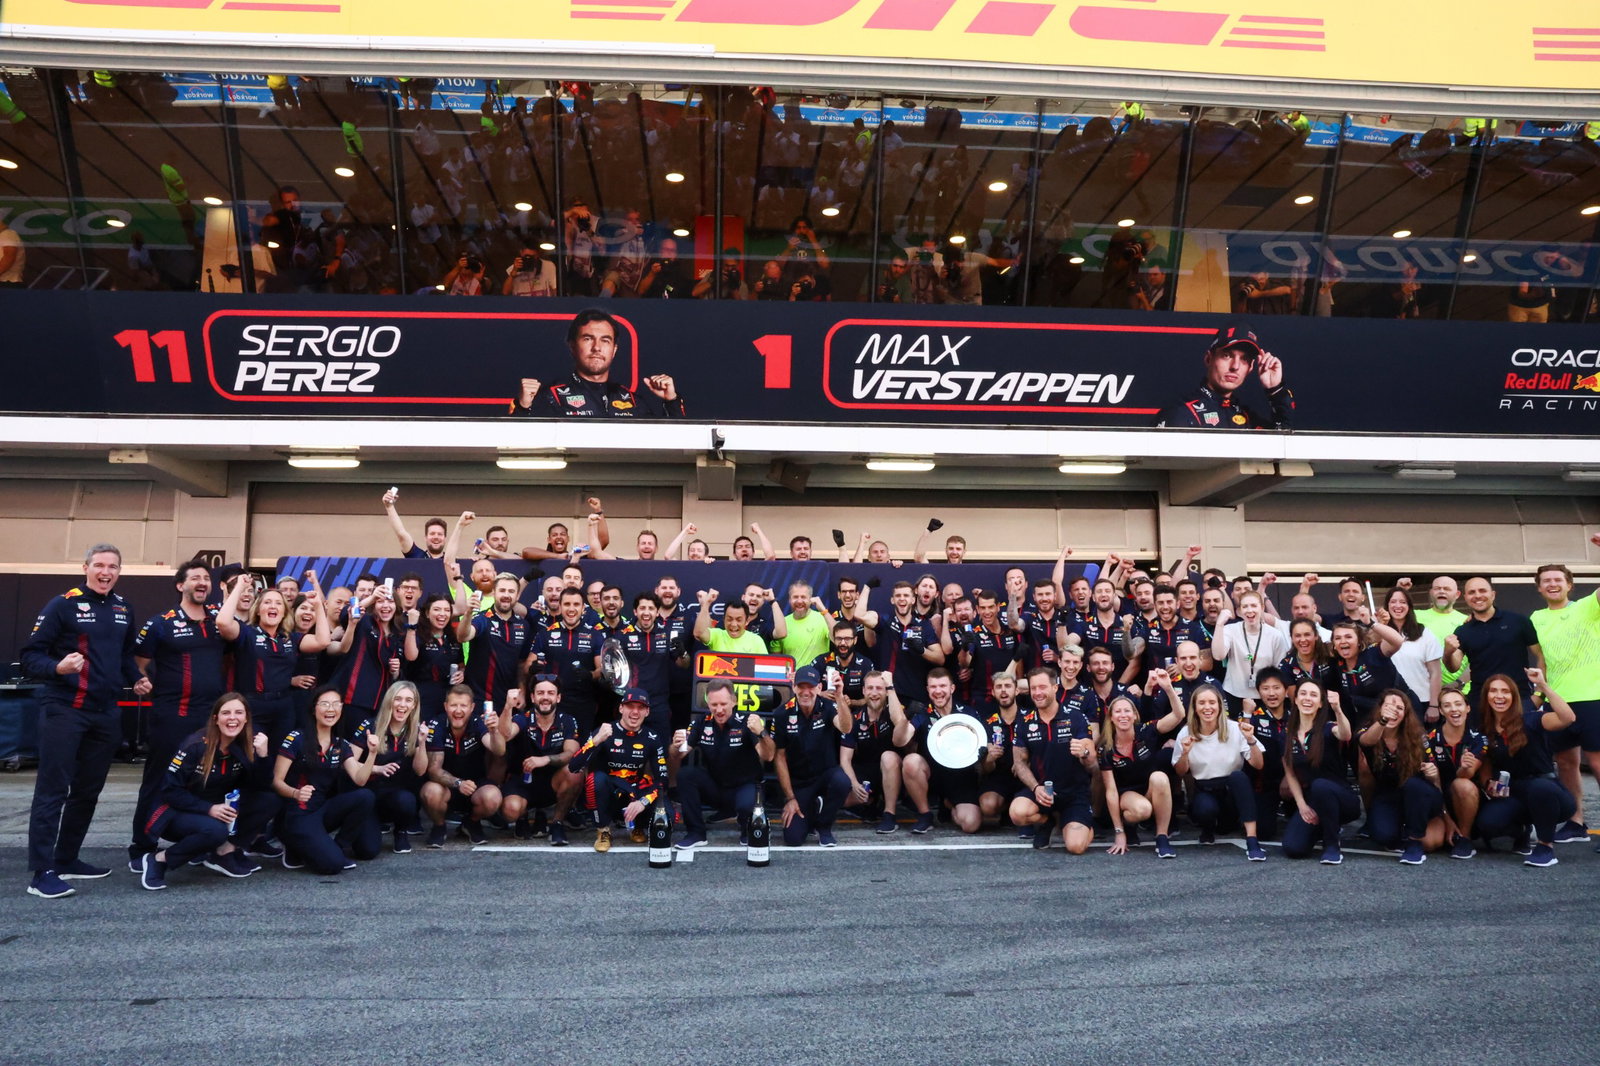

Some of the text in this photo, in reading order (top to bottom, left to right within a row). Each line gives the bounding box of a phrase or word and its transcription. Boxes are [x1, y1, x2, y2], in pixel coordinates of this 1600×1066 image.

[114, 330, 191, 382] 11
[239, 325, 401, 357] SERGIO
[855, 334, 970, 366] MAX
[233, 361, 381, 393] PEREZ
[752, 335, 791, 388] 1
[852, 369, 1134, 404] VERSTAPPEN
[1504, 373, 1573, 390] Red Bull
[608, 761, 644, 769] ORACLE
